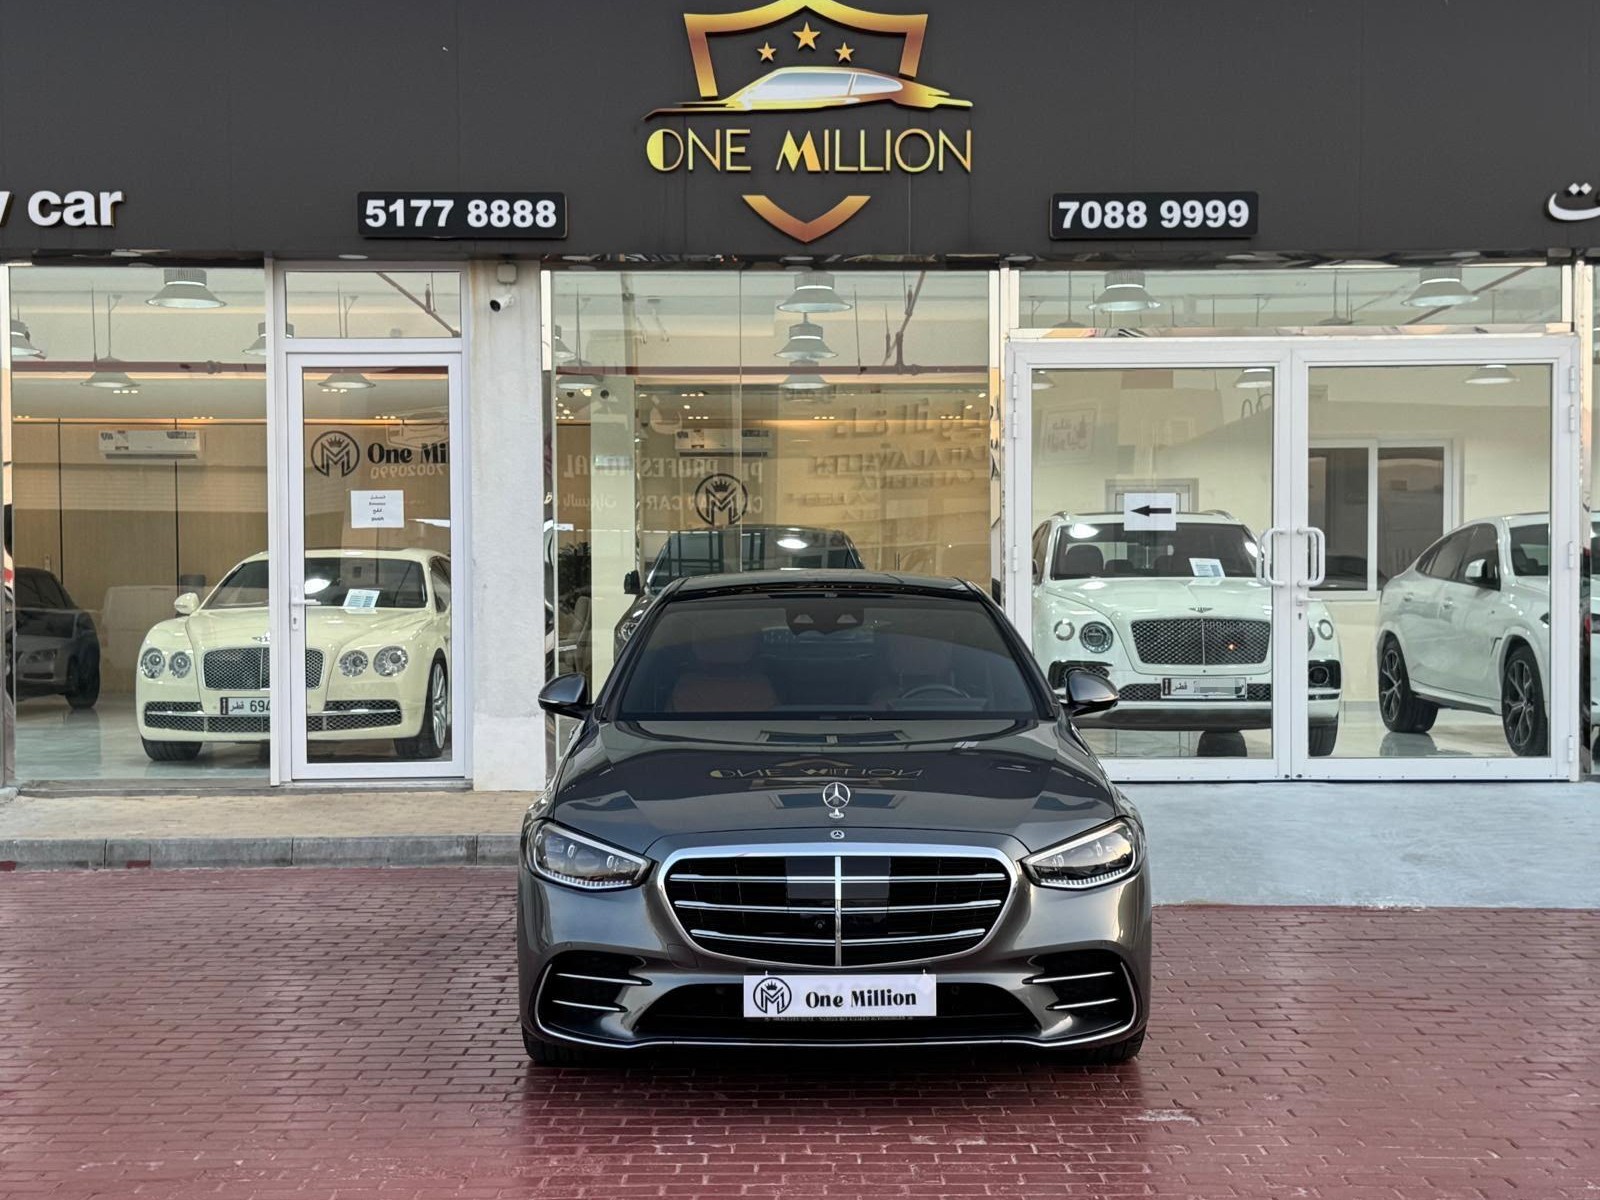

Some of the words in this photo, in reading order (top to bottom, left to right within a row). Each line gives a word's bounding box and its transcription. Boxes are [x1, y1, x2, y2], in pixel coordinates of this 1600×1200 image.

[646, 128, 751, 173] ONE
[775, 128, 973, 174] MILLION
[28, 190, 124, 227] car
[365, 198, 454, 229] 5177
[467, 198, 557, 229] 8888
[1058, 200, 1148, 229] 7088
[1160, 200, 1250, 229] 9999
[367, 443, 413, 464] One
[229, 701, 245, 712] قطر
[805, 991, 844, 1008] One
[850, 988, 917, 1008] Million
